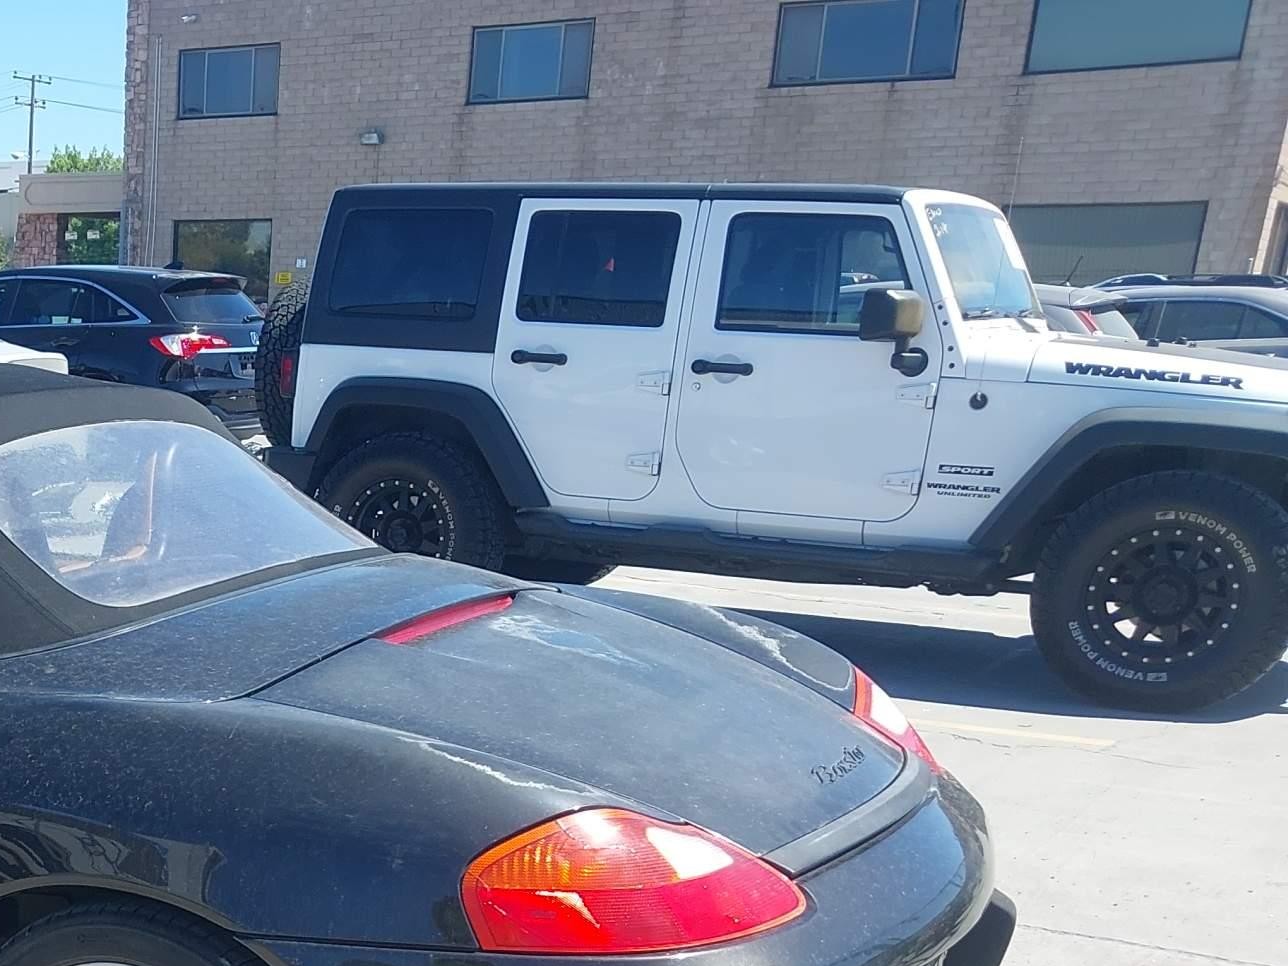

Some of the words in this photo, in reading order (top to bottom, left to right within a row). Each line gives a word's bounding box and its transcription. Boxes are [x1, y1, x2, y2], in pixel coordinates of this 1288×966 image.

[1064, 361, 1244, 390] WRANGLER
[938, 464, 995, 476] SPORT
[927, 482, 1001, 494] WRANGLER
[936, 490, 991, 499] UNLIMITED
[1178, 511, 1228, 535] VENOM
[1225, 532, 1257, 573] POWER
[1068, 619, 1099, 660] POWER
[1095, 657, 1144, 681] VENOM
